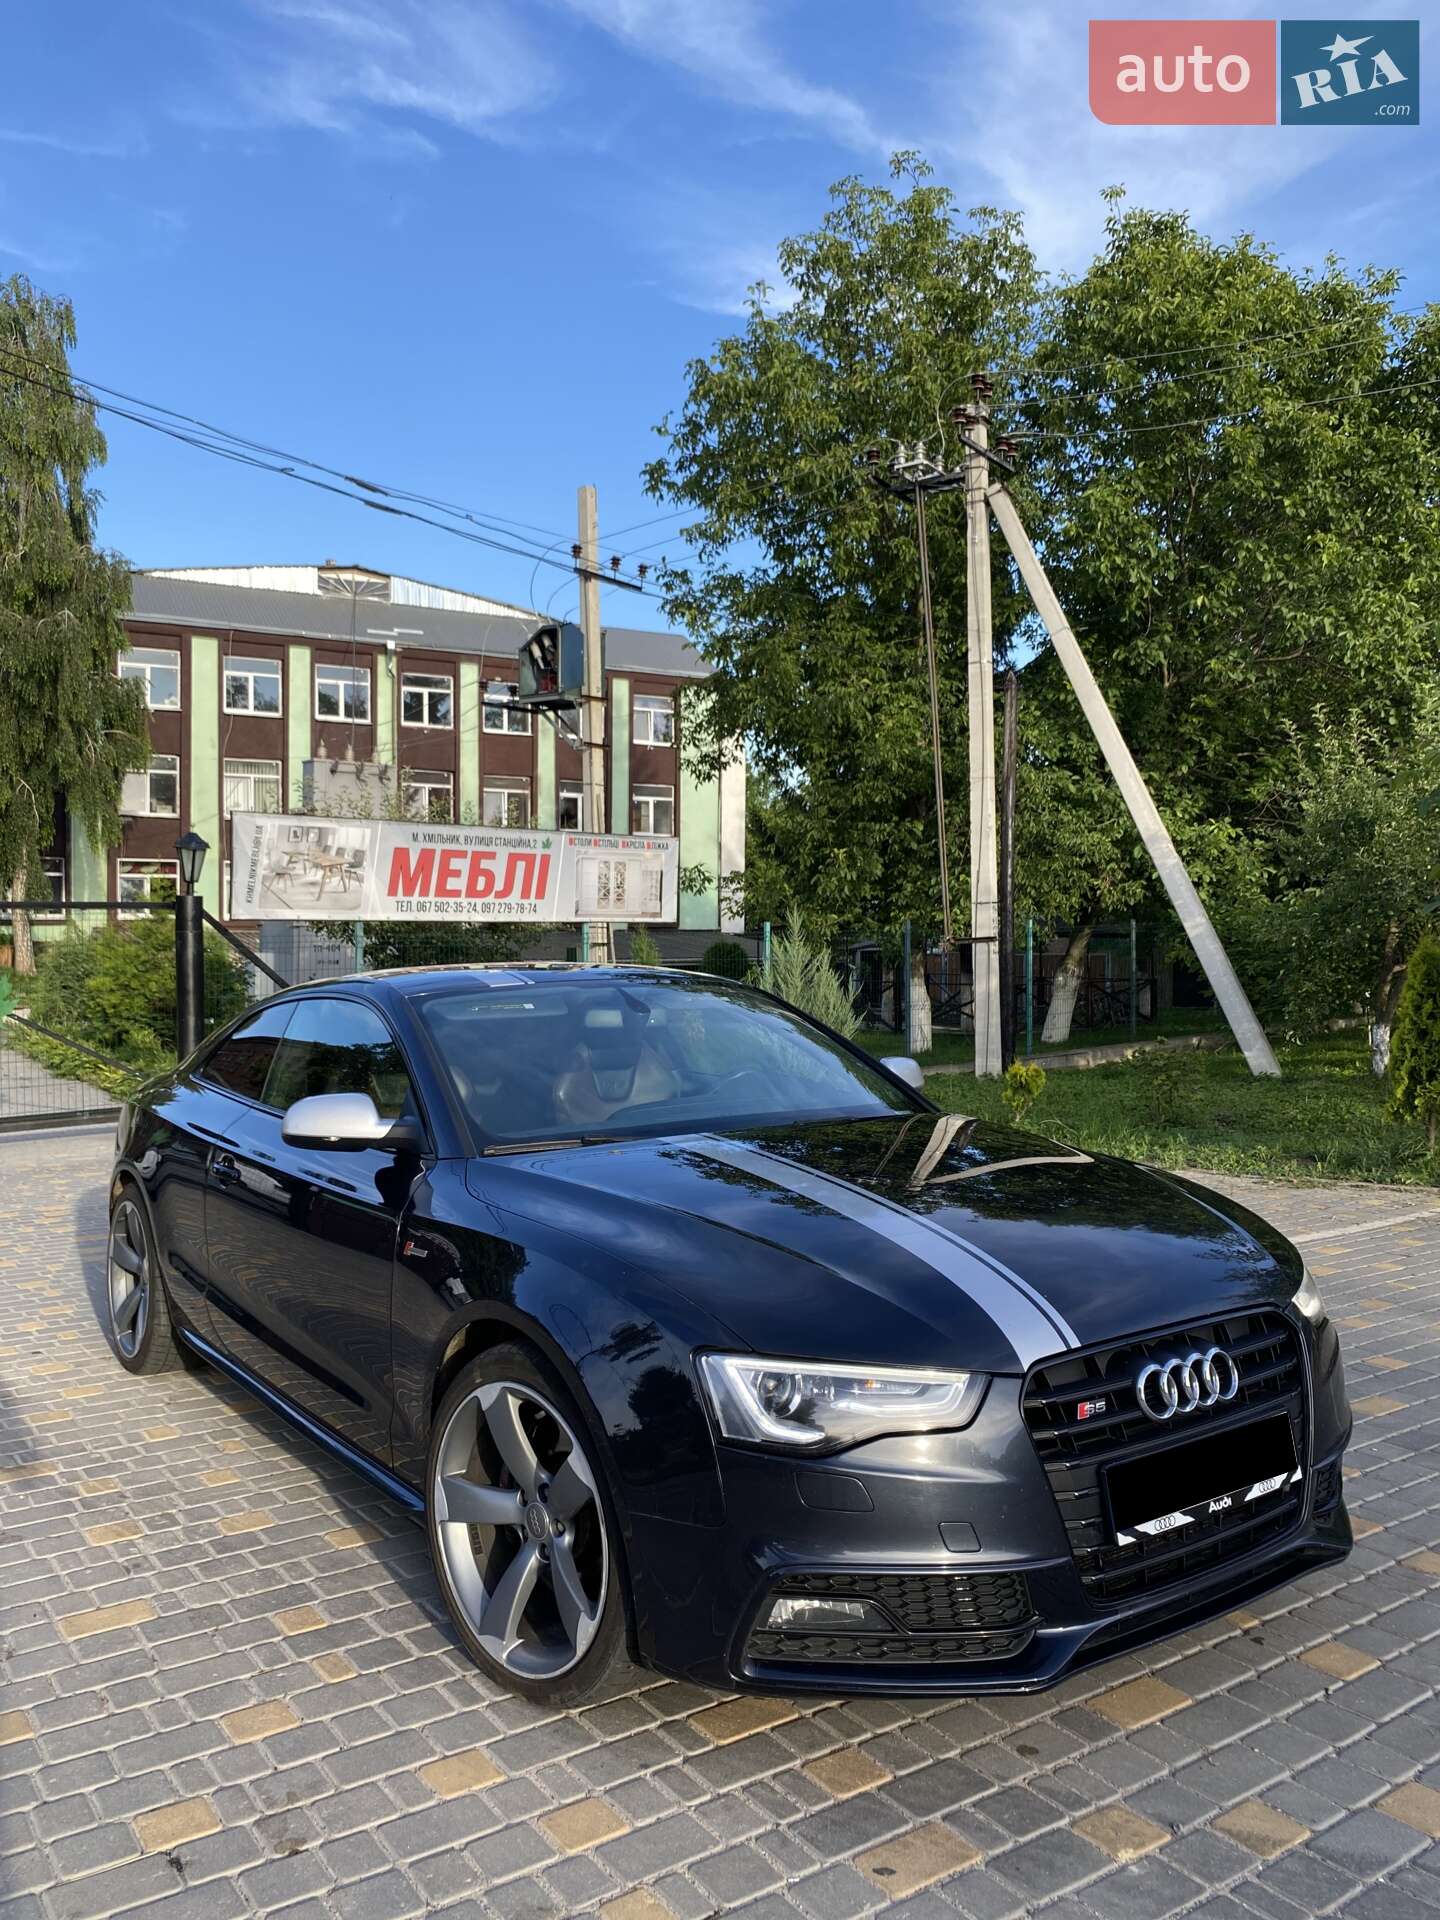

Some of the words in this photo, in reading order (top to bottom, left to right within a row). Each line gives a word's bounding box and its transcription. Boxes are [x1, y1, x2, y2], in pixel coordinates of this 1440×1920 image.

[412, 832, 419, 842] М.
[422, 833, 463, 846] ХМІЛЬНИК,
[464, 835, 494, 847] ВУЛИЦЯ
[387, 847, 552, 900] МЕБЛІ
[395, 901, 414, 913] ТЕЛ.
[416, 901, 432, 913] 067
[481, 902, 496, 914] 097
[499, 903, 537, 914] 279-78-74
[1208, 1496, 1232, 1514] Audi
